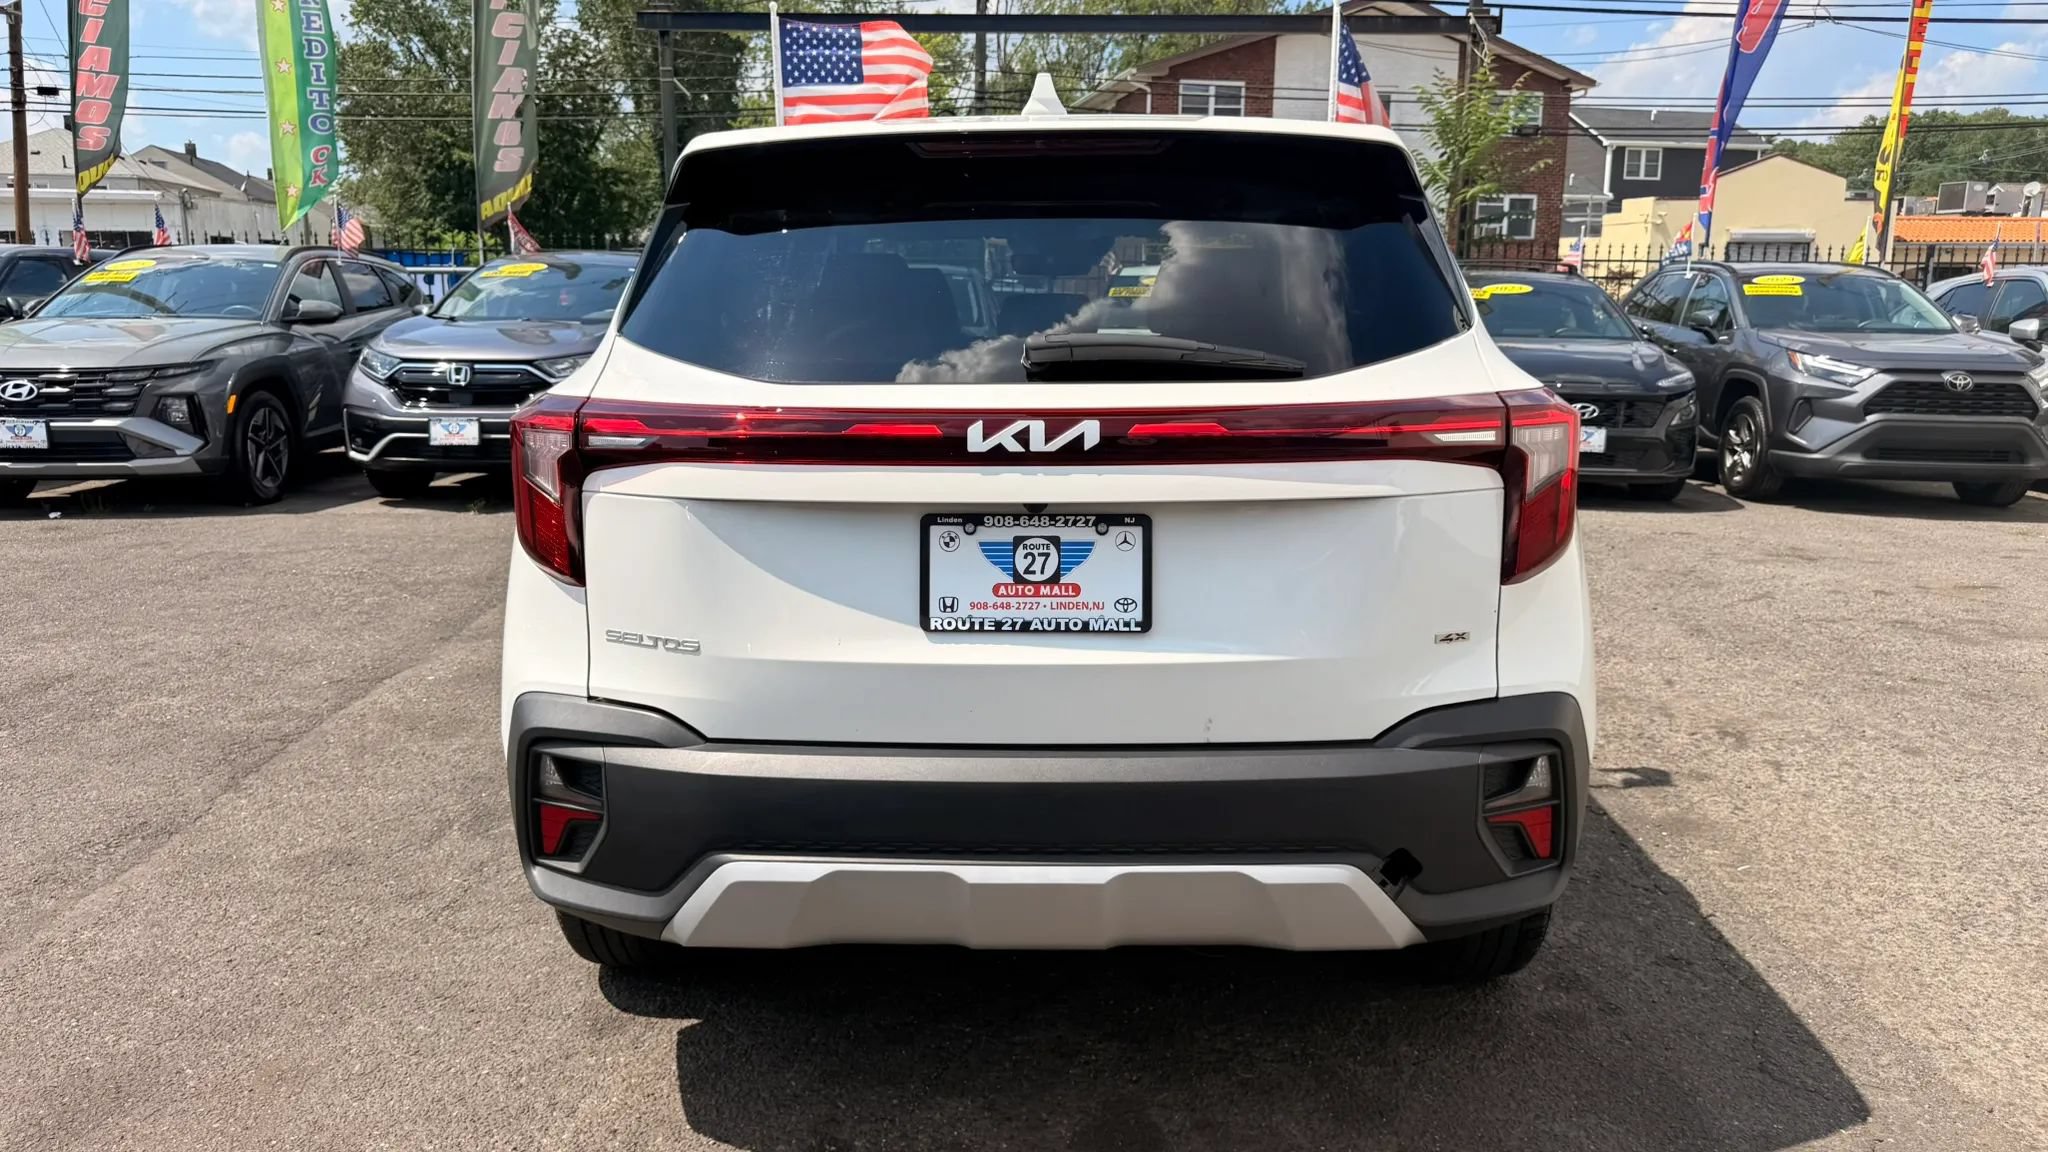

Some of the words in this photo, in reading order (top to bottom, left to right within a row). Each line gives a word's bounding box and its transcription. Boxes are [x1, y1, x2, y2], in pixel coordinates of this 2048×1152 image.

[300, 0, 333, 135] EDITO
[488, 0, 528, 172] CIAMOS
[967, 420, 1101, 452] KIA
[983, 515, 1096, 528] 908-648-2727
[1124, 516, 1136, 524] NJ
[1022, 543, 1051, 551] ROUTE
[1022, 551, 1051, 575] 27
[997, 585, 1033, 596] AUTO
[1039, 585, 1076, 596] MALL
[969, 601, 1041, 611] 908-648-2727
[1050, 601, 1105, 612] LINDEN,NJ
[929, 616, 996, 632] ROUTE
[1001, 617, 1022, 632] 27
[1029, 617, 1083, 632] AUTO
[1088, 617, 1142, 632] MALL
[605, 629, 701, 655] SELTOS
